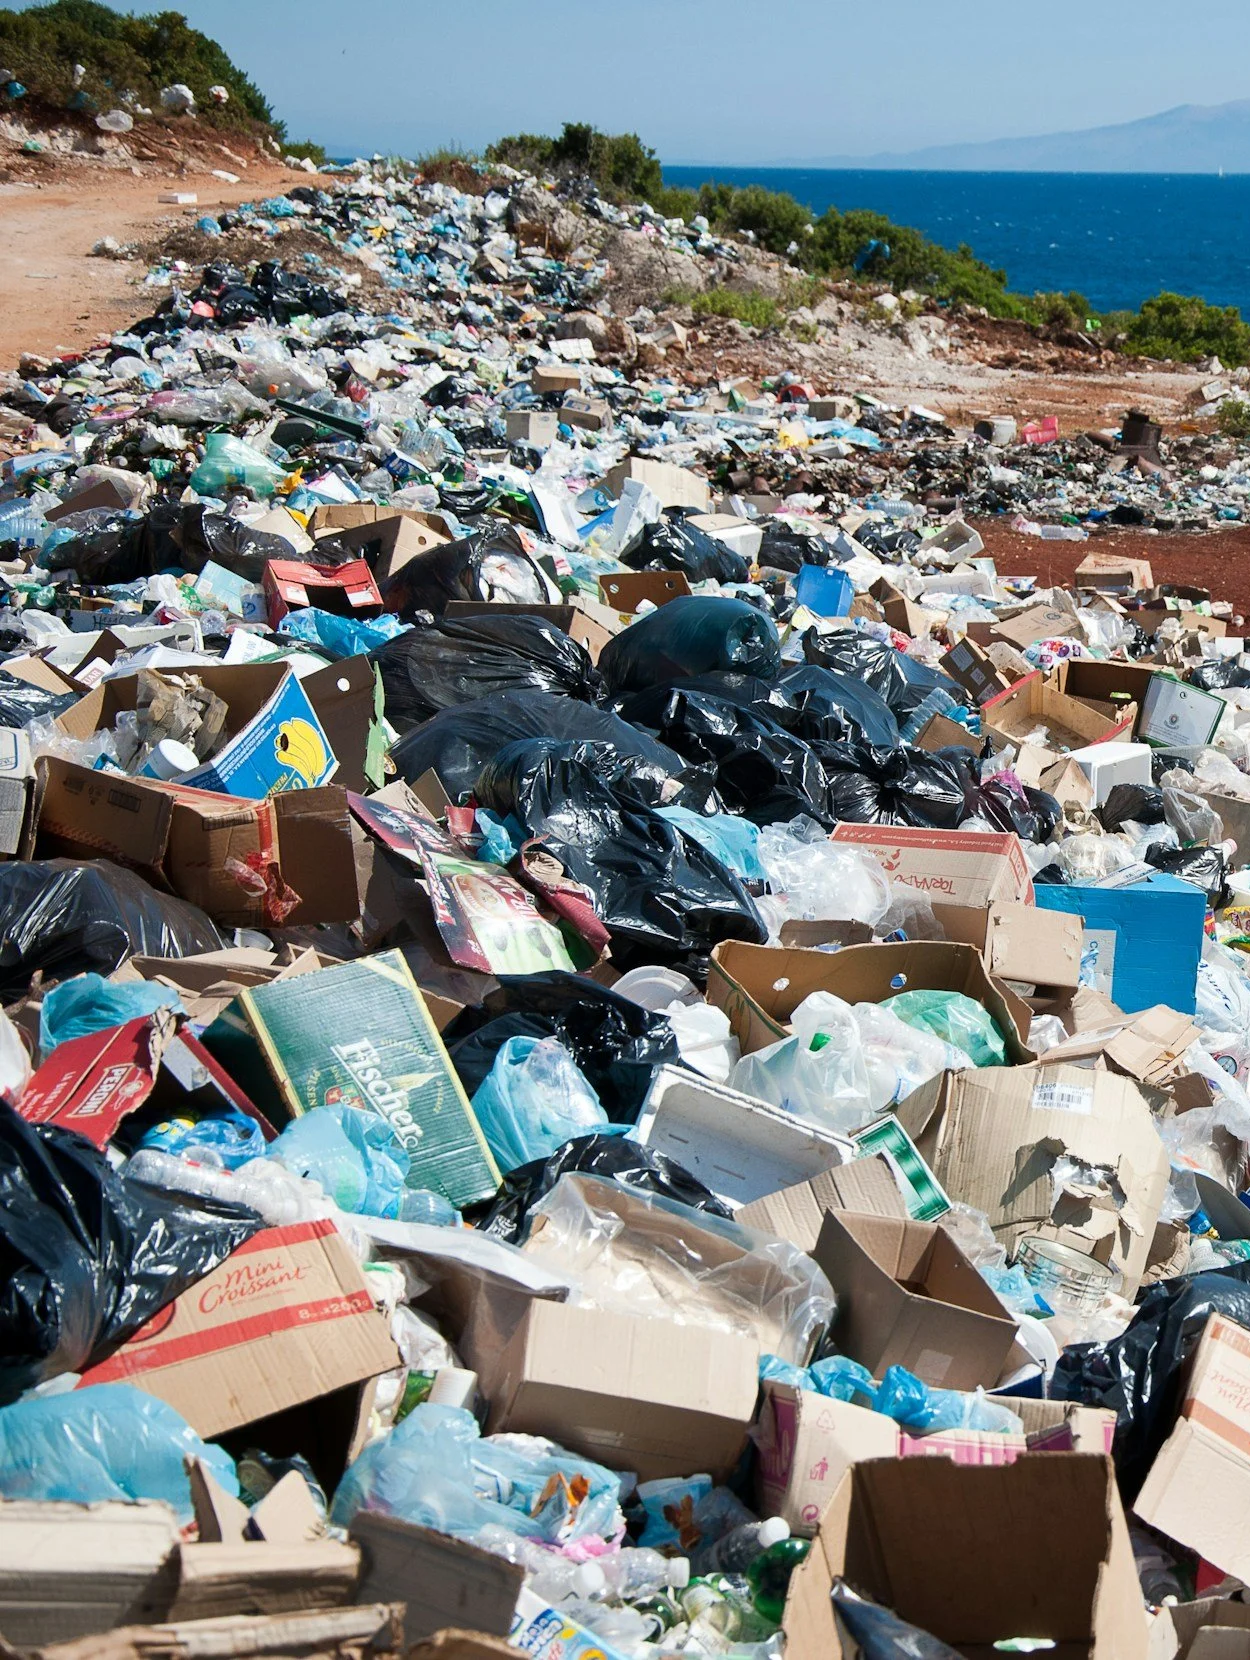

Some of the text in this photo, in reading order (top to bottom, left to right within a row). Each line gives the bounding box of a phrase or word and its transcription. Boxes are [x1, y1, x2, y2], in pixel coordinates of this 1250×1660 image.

[77, 1066, 128, 1114] PERONI
[334, 1037, 424, 1140] Fischer
[199, 1265, 311, 1314] Croissant
[225, 1256, 284, 1288] Mini
